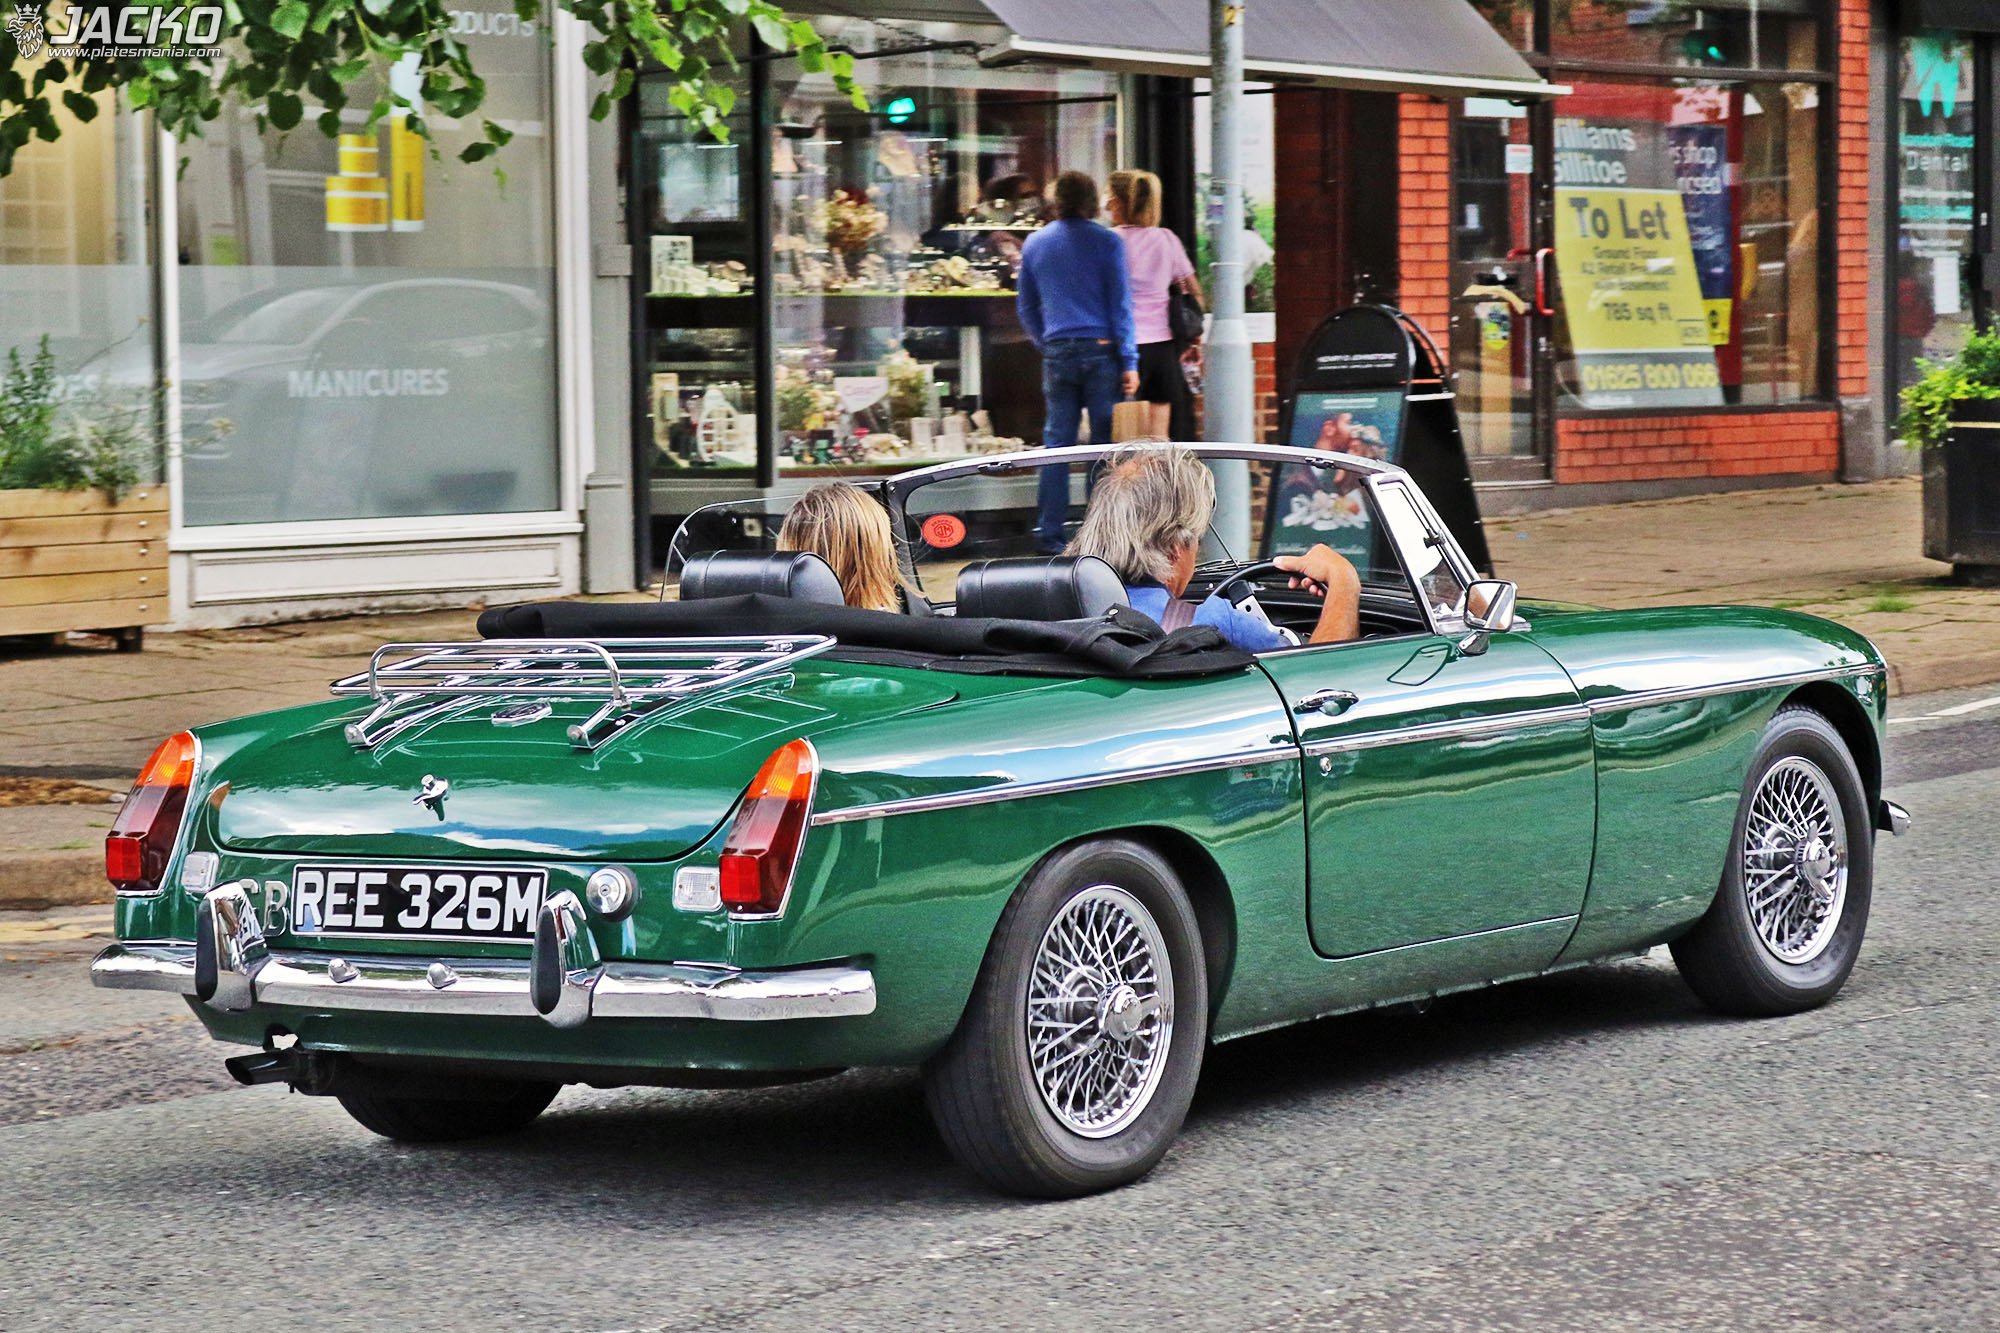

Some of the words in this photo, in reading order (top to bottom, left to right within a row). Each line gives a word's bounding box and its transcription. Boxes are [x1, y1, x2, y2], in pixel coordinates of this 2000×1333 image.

[446, 10, 535, 37] ODUCTS
[1906, 150, 1969, 172] Dental
[1569, 197, 1610, 239] To
[1618, 198, 1671, 240] Let
[288, 368, 449, 398] MANICURES
[295, 870, 388, 929] REE
[397, 873, 542, 933] 326M
